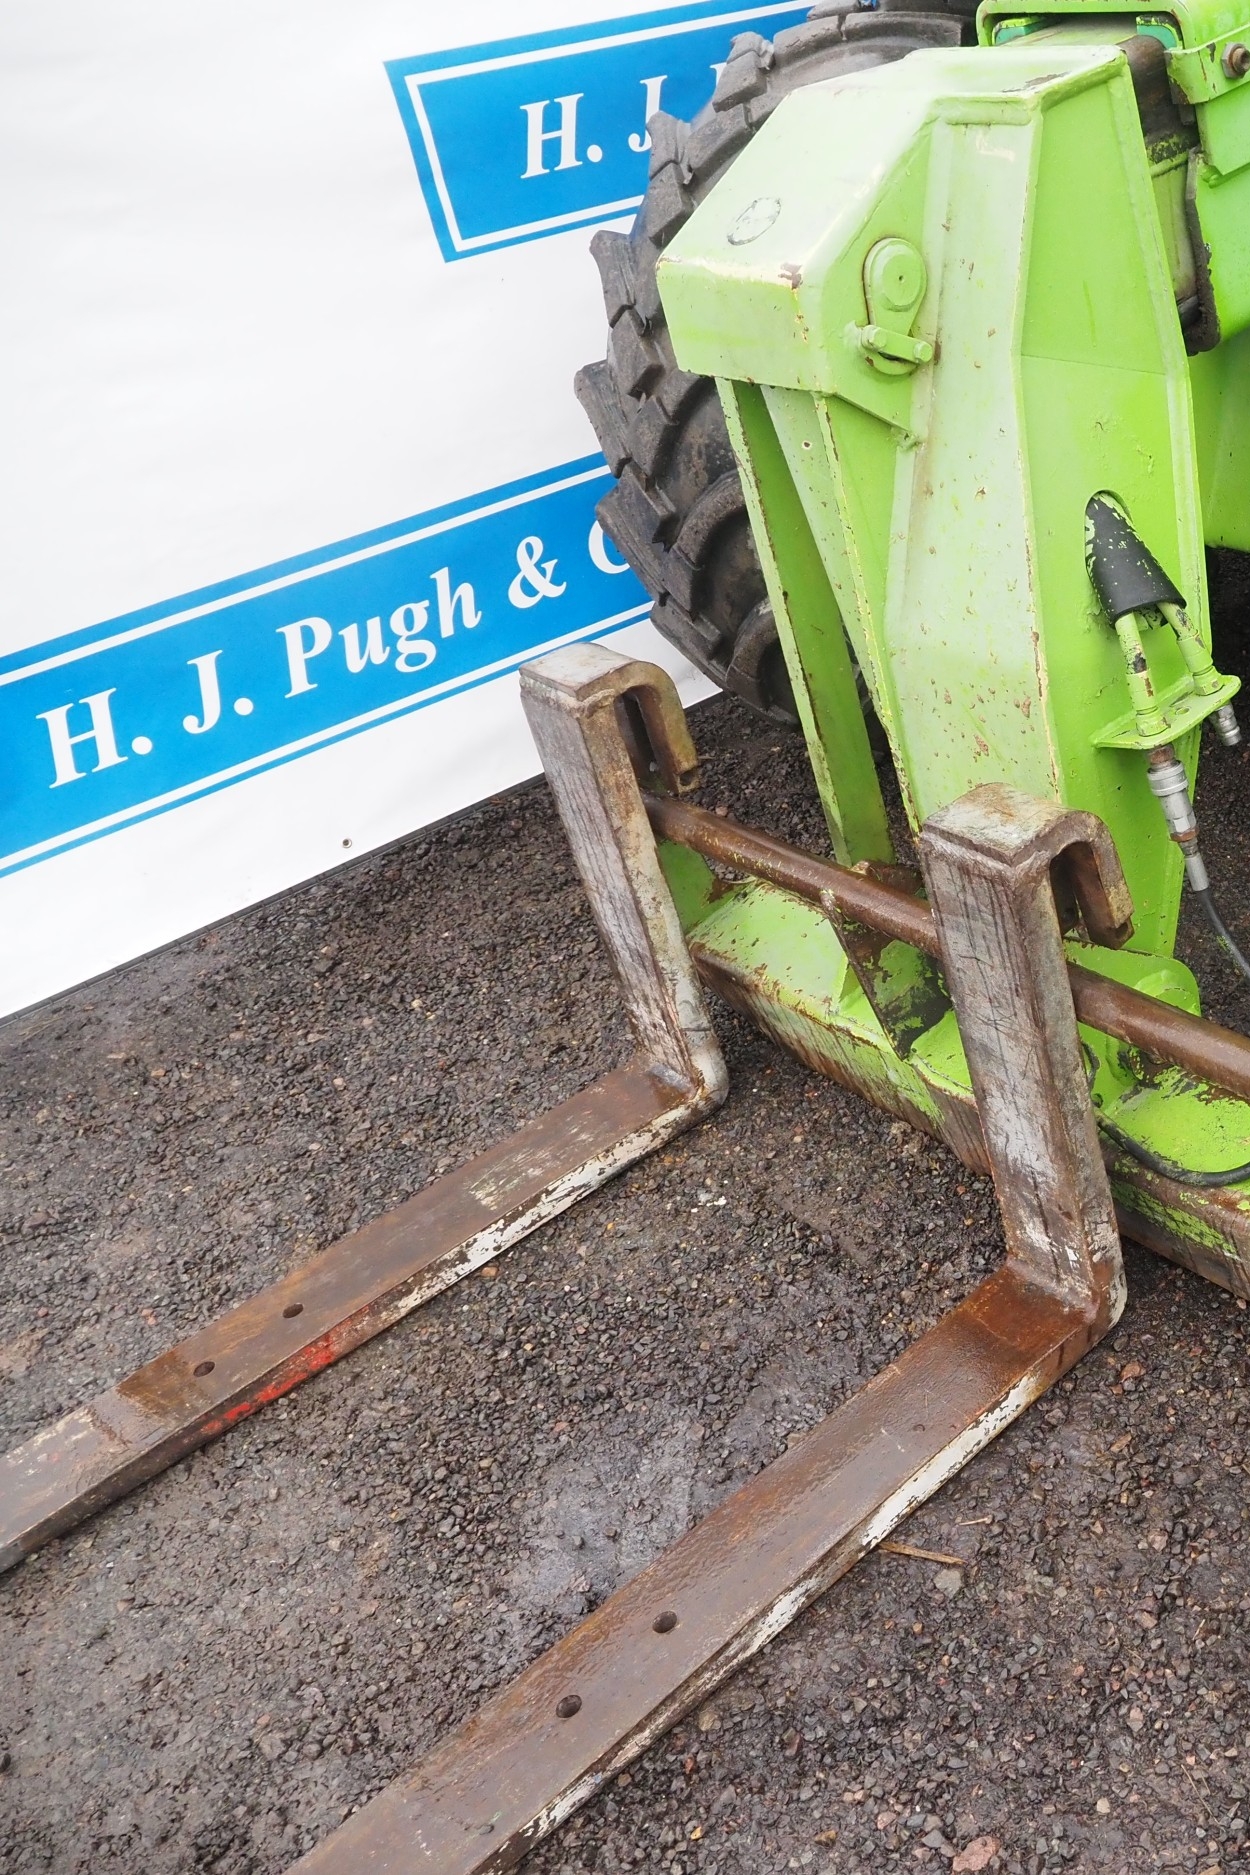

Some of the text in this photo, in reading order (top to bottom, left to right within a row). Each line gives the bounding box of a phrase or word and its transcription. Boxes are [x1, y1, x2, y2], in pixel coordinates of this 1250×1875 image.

[519, 92, 604, 179] H.
[36, 687, 153, 789] H.
[182, 649, 254, 735] J.
[275, 566, 482, 699] Pugh
[507, 535, 567, 609] &
